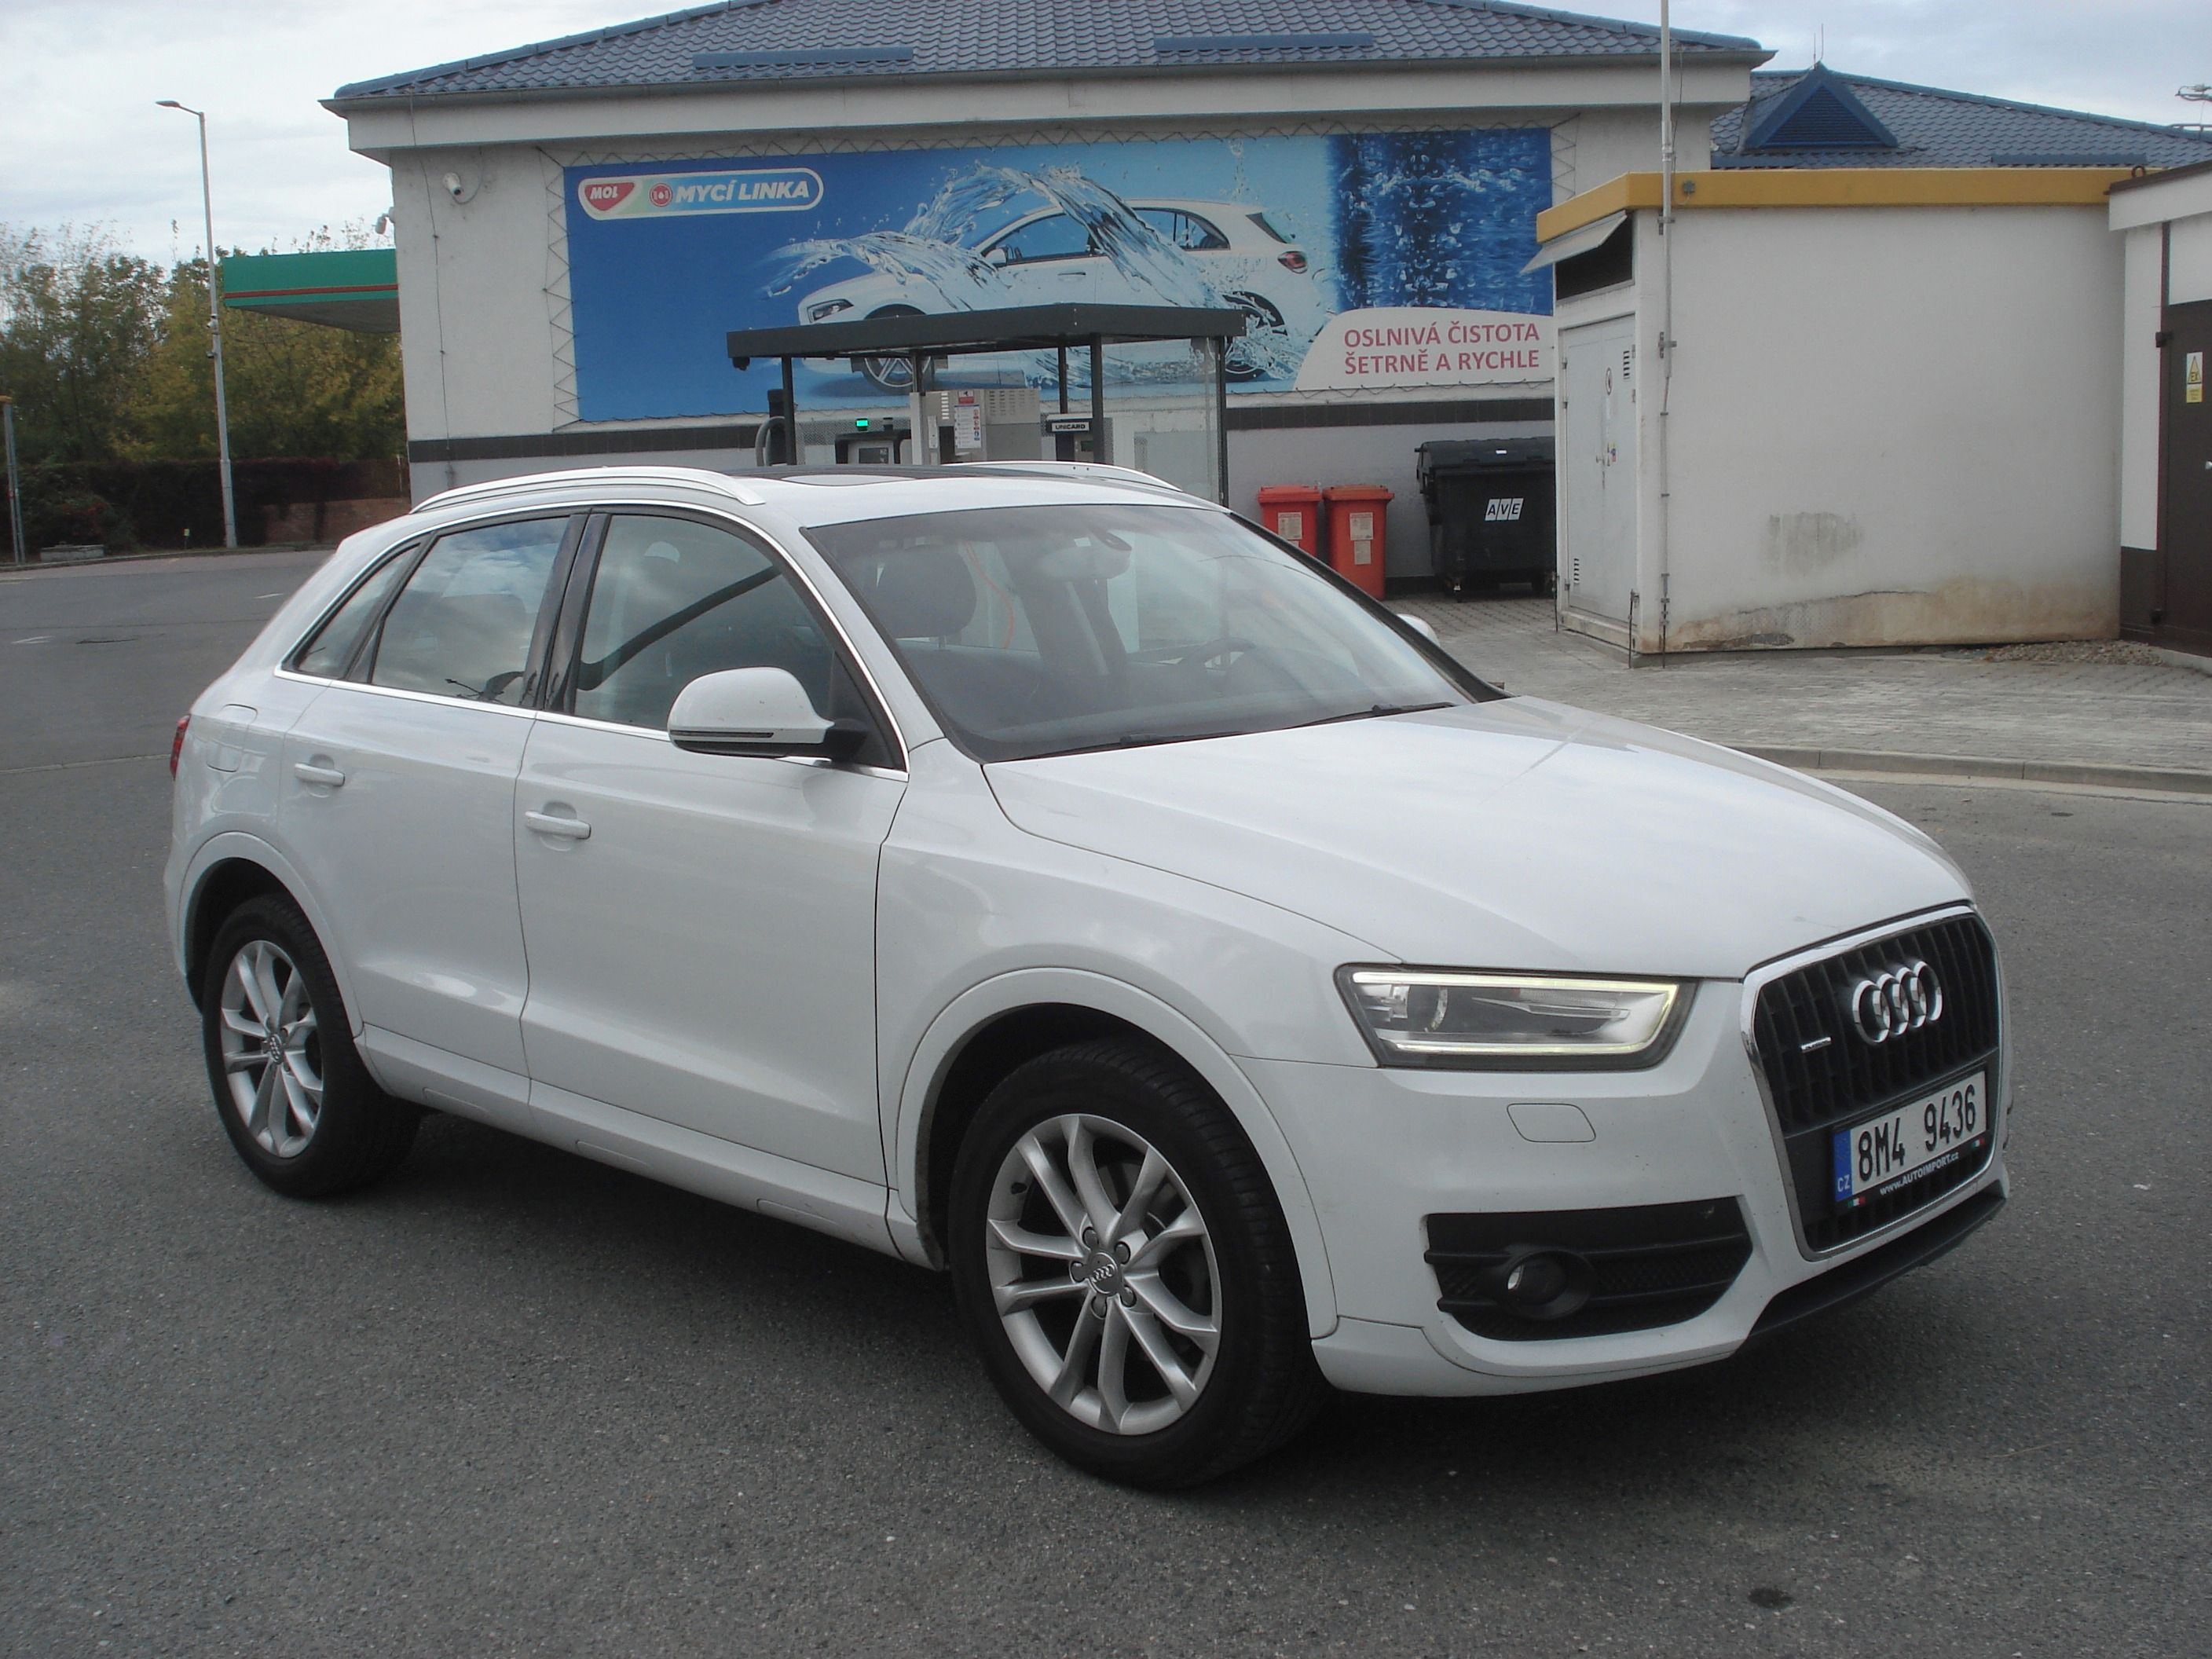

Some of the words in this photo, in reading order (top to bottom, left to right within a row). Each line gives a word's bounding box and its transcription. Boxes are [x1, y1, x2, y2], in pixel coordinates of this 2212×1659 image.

[590, 185, 619, 200] MOL
[676, 180, 737, 203] MYCÍ
[738, 181, 810, 200] LINKA
[1344, 322, 1441, 347] OSLNIVÁ
[1448, 321, 1540, 344] ČISTOTA
[1345, 349, 1429, 375] ŠETRNĚ
[1436, 353, 1451, 372] A
[1459, 350, 1540, 370] RYCHLE
[1486, 502, 1521, 516] AVE
[1858, 1116, 1906, 1181] 8M4
[1925, 1084, 1976, 1152] 9436
[1837, 1174, 1851, 1192] CZ
[1880, 1152, 1959, 1196] www.AUTOIMPORT.cz
